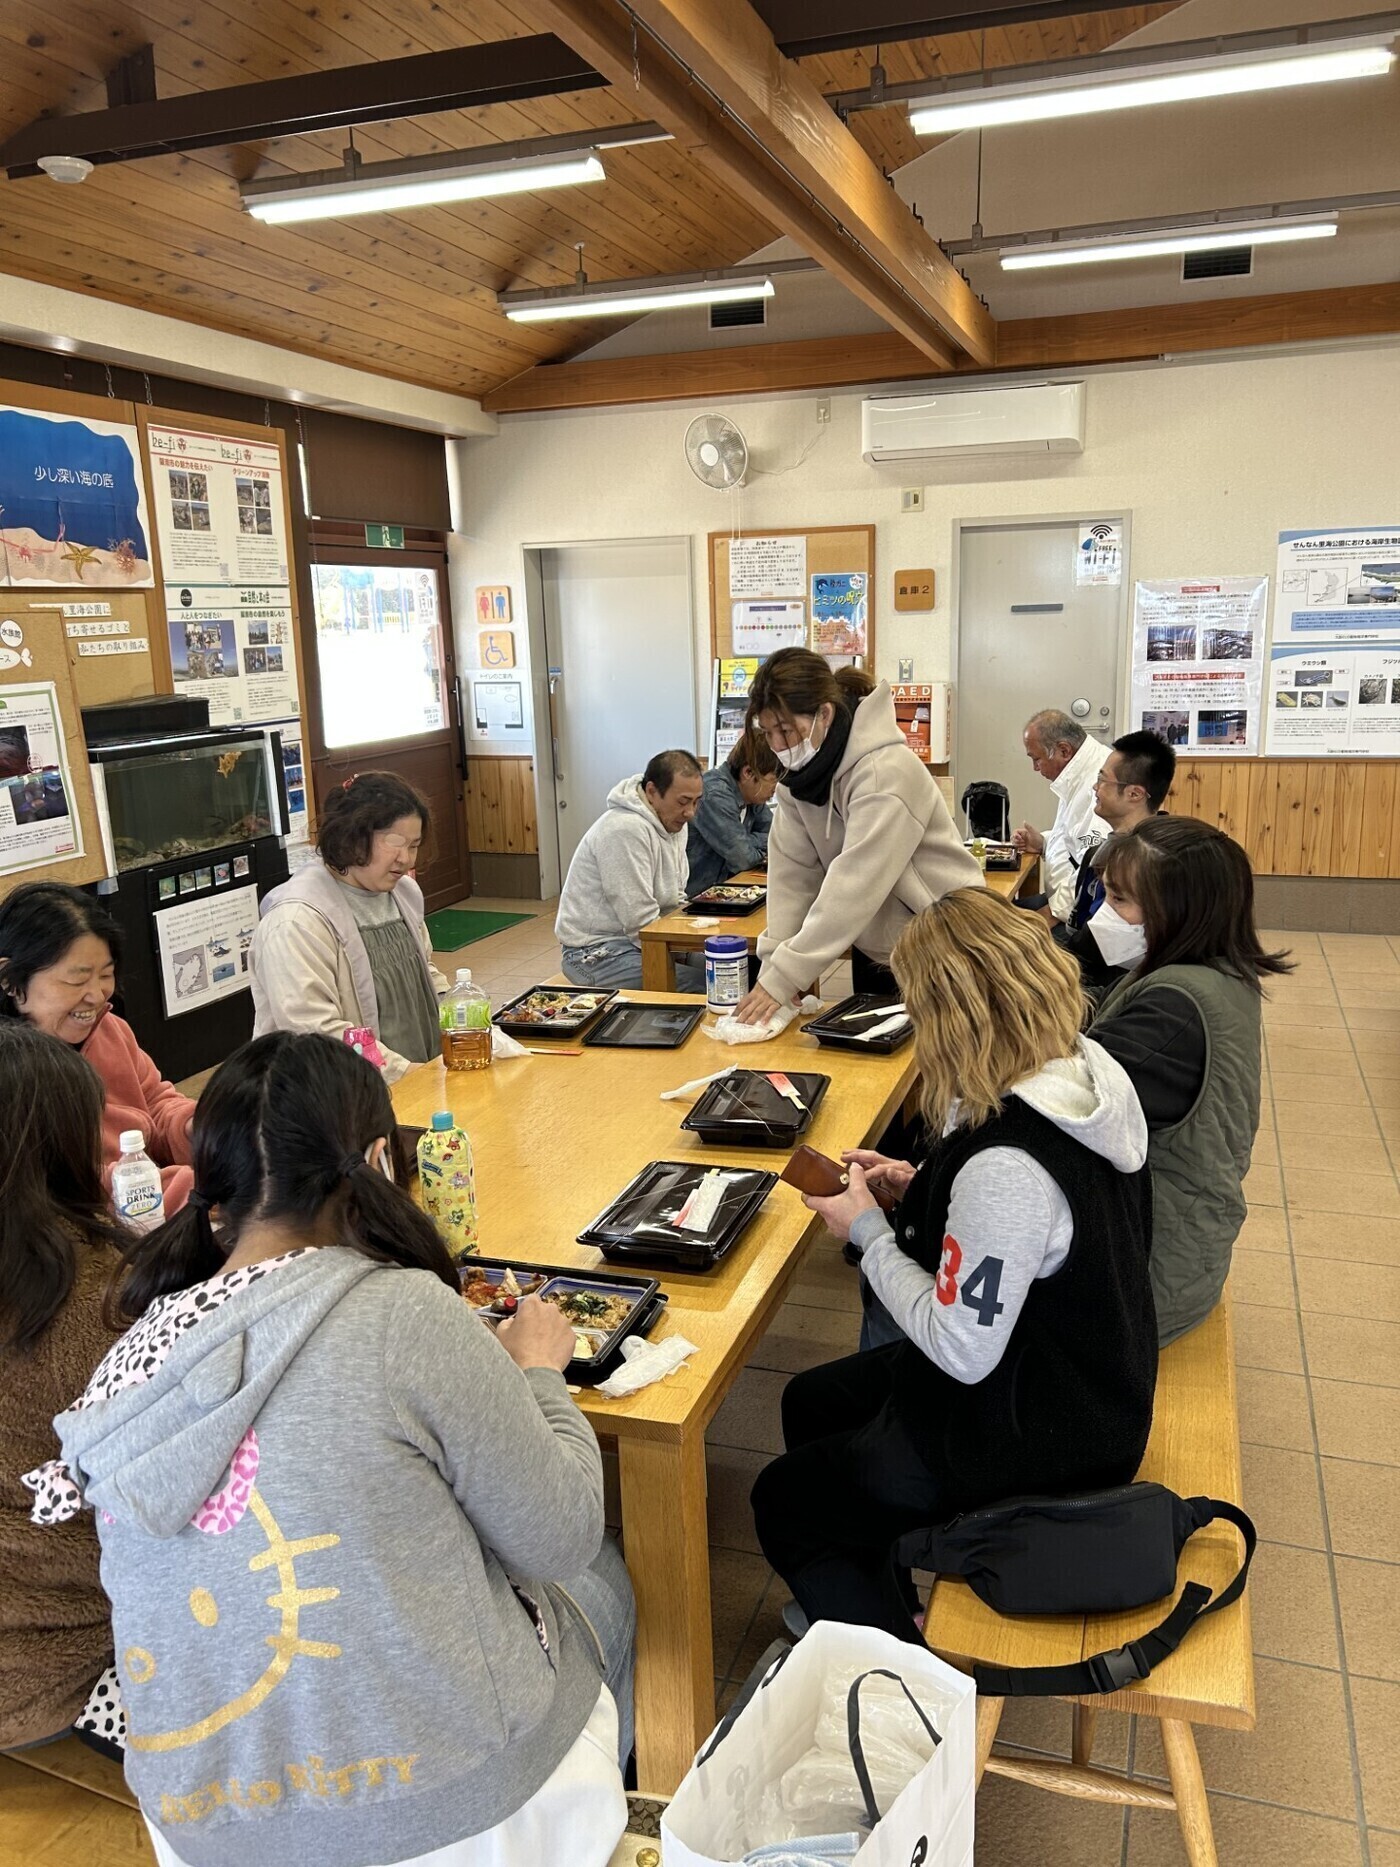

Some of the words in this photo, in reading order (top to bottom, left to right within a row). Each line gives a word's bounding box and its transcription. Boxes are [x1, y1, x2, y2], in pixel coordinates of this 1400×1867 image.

[34, 465, 114, 488] 少し深い海の底
[80, 640, 146, 654] 私たちの取り組み
[897, 686, 931, 696] AED
[126, 1184, 156, 1197] SPORTS
[127, 1192, 155, 1205] DRINK
[131, 1200, 153, 1210] ZERO
